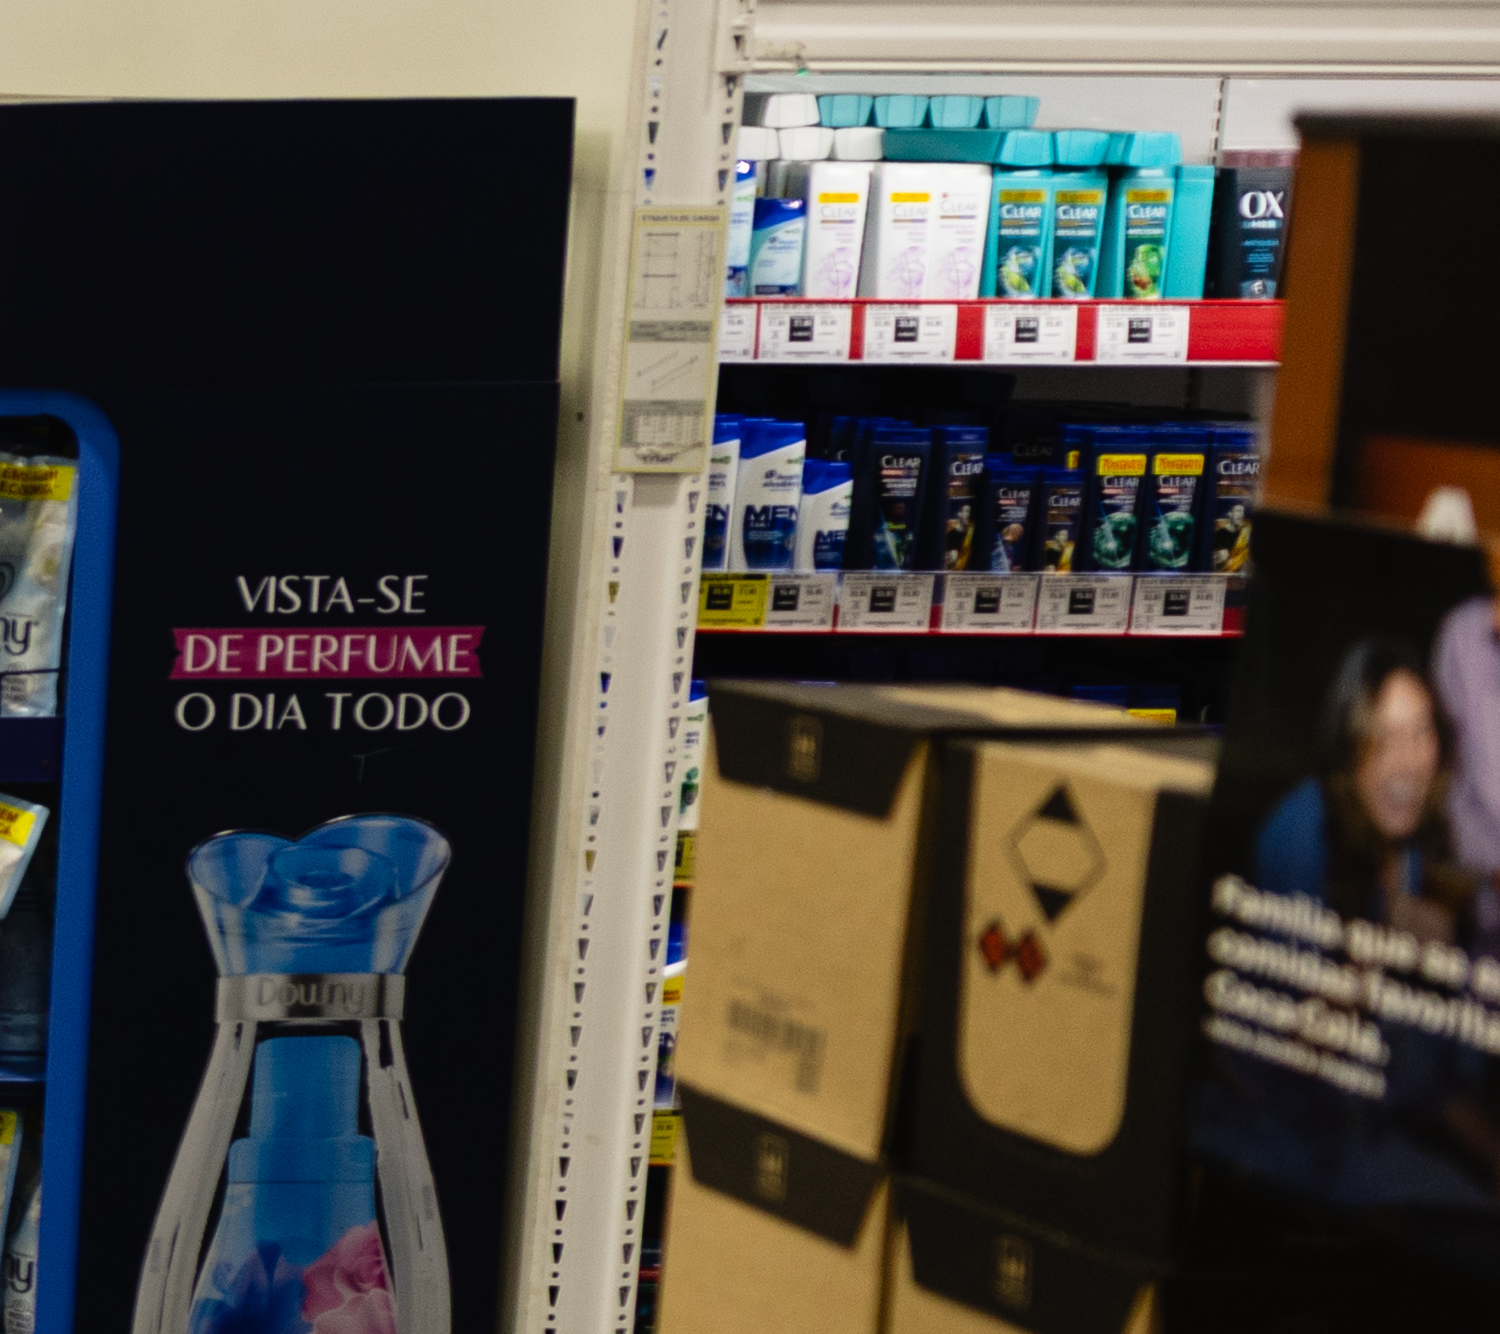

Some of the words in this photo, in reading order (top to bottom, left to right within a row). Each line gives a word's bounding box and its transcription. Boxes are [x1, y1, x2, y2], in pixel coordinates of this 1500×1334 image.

[1239, 190, 1285, 219] OX
[236, 573, 429, 617] VISTA-SE
[184, 633, 247, 674] DE
[256, 633, 474, 674] PERFUME
[175, 692, 216, 733] O
[227, 692, 308, 733] DIA
[326, 692, 471, 733] TODO
